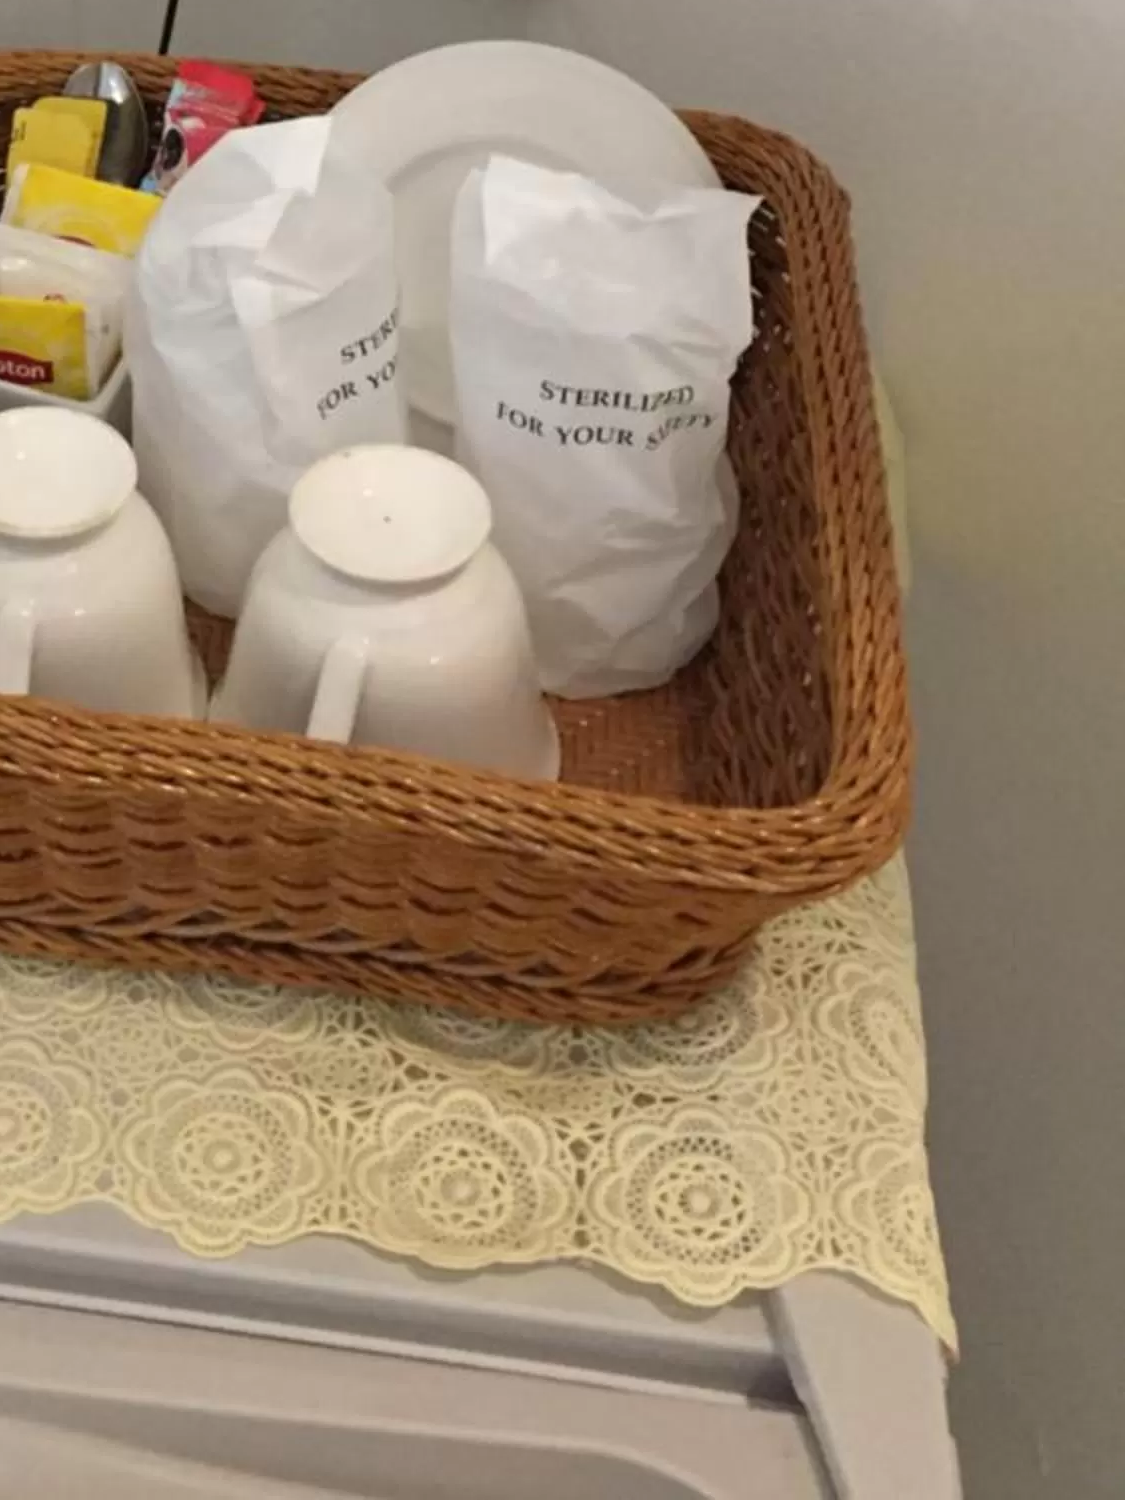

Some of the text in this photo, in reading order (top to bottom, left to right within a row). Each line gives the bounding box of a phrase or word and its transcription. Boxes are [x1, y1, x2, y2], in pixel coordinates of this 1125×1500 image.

[316, 357, 397, 421] FOR YO
[538, 380, 694, 412] STERILIZED
[496, 401, 543, 437] FOR
[553, 425, 634, 446] YOUR
